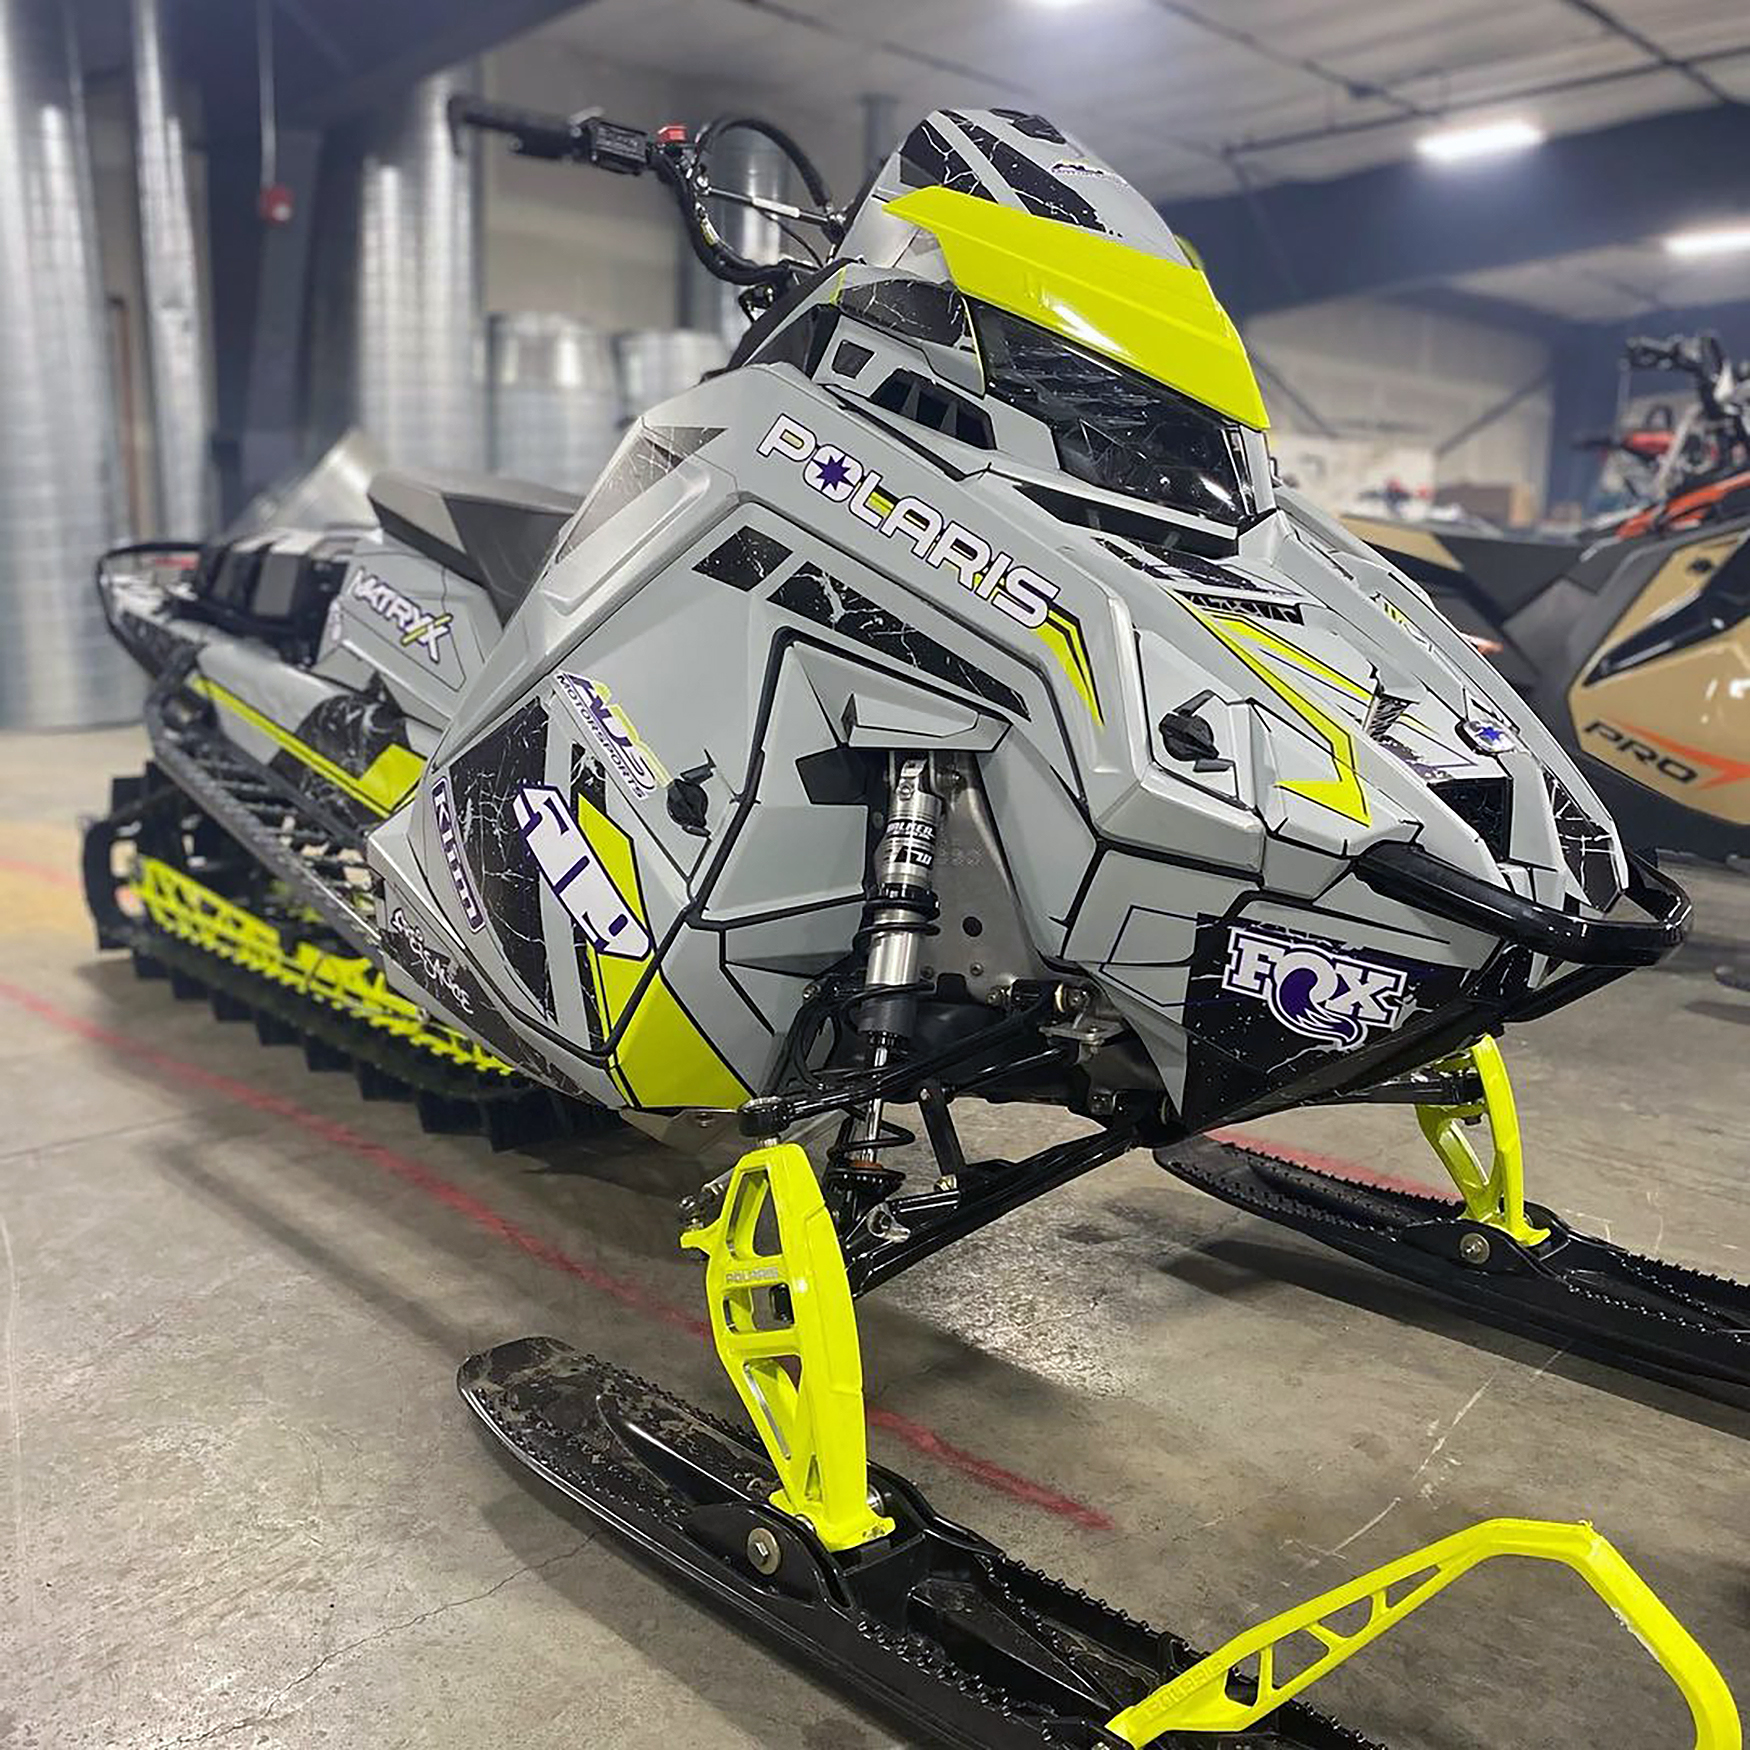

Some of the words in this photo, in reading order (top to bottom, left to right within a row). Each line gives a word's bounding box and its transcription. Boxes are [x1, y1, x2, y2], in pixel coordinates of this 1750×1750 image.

[757, 412, 1061, 629] POLARIS
[346, 567, 454, 664] MATRYX
[556, 674, 647, 798] MOTORSPORTS
[1584, 721, 1698, 783] PRO
[512, 786, 650, 960] 509
[1223, 927, 1407, 1050] FOX
